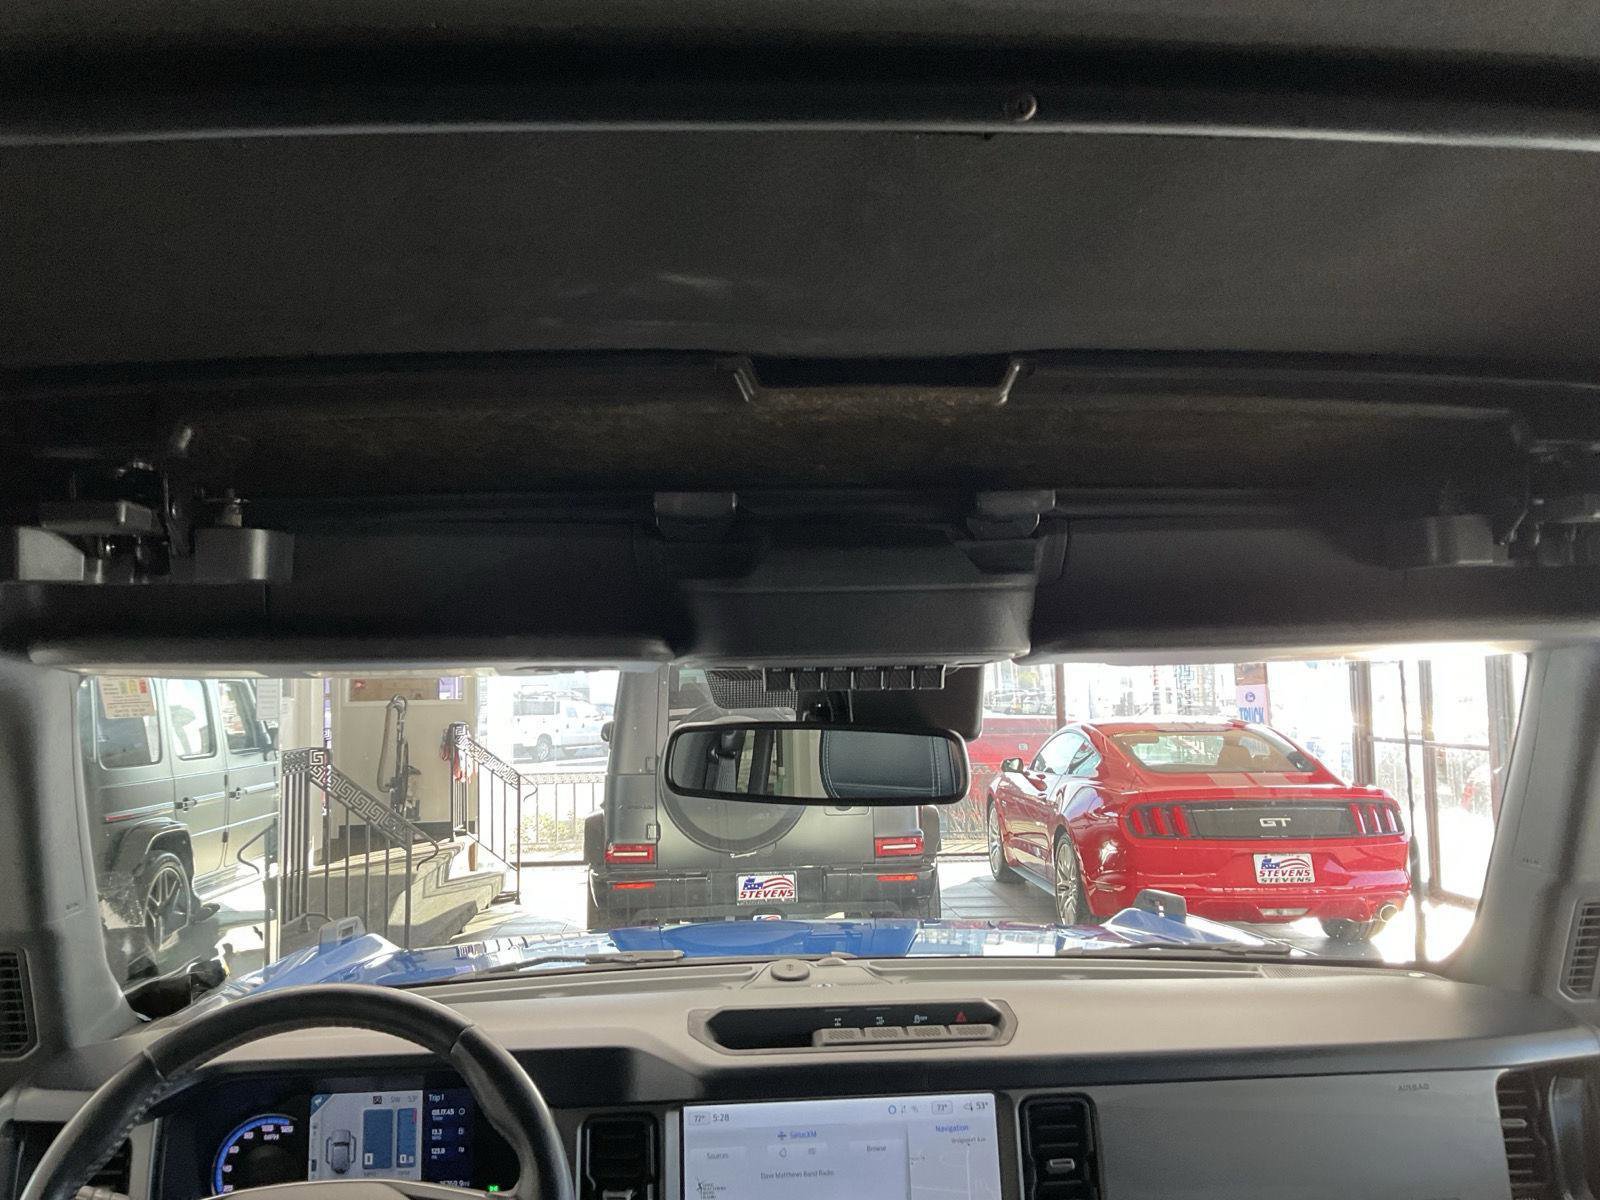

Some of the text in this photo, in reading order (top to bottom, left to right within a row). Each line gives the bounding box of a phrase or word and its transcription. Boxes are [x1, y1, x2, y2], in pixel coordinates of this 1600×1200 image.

[1260, 817, 1291, 827] GT
[1260, 869, 1311, 877] STEVENS
[740, 889, 794, 899] STEVENS
[428, 1093, 441, 1103] Trip
[713, 1113, 730, 1122] 5:28
[935, 1124, 969, 1133] Navigation
[775, 1171, 803, 1179] Matthews
